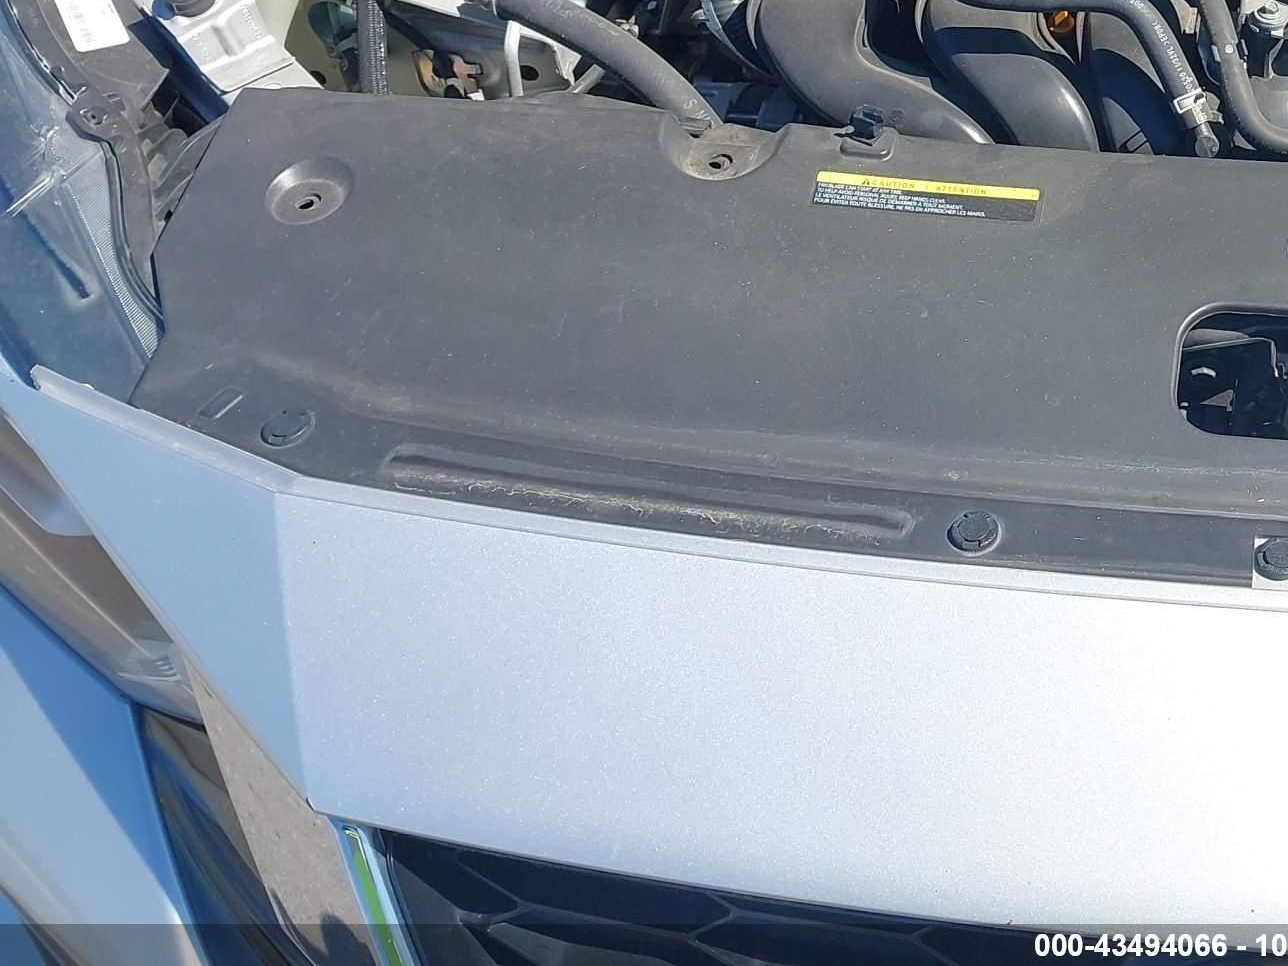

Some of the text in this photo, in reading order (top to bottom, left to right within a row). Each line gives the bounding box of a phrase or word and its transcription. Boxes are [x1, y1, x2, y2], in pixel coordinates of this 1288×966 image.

[872, 178, 915, 189] CAUTION
[936, 185, 987, 195] ATTENTION
[822, 193, 858, 201] VENTILATEUR
[924, 207, 956, 215] APPROCHER
